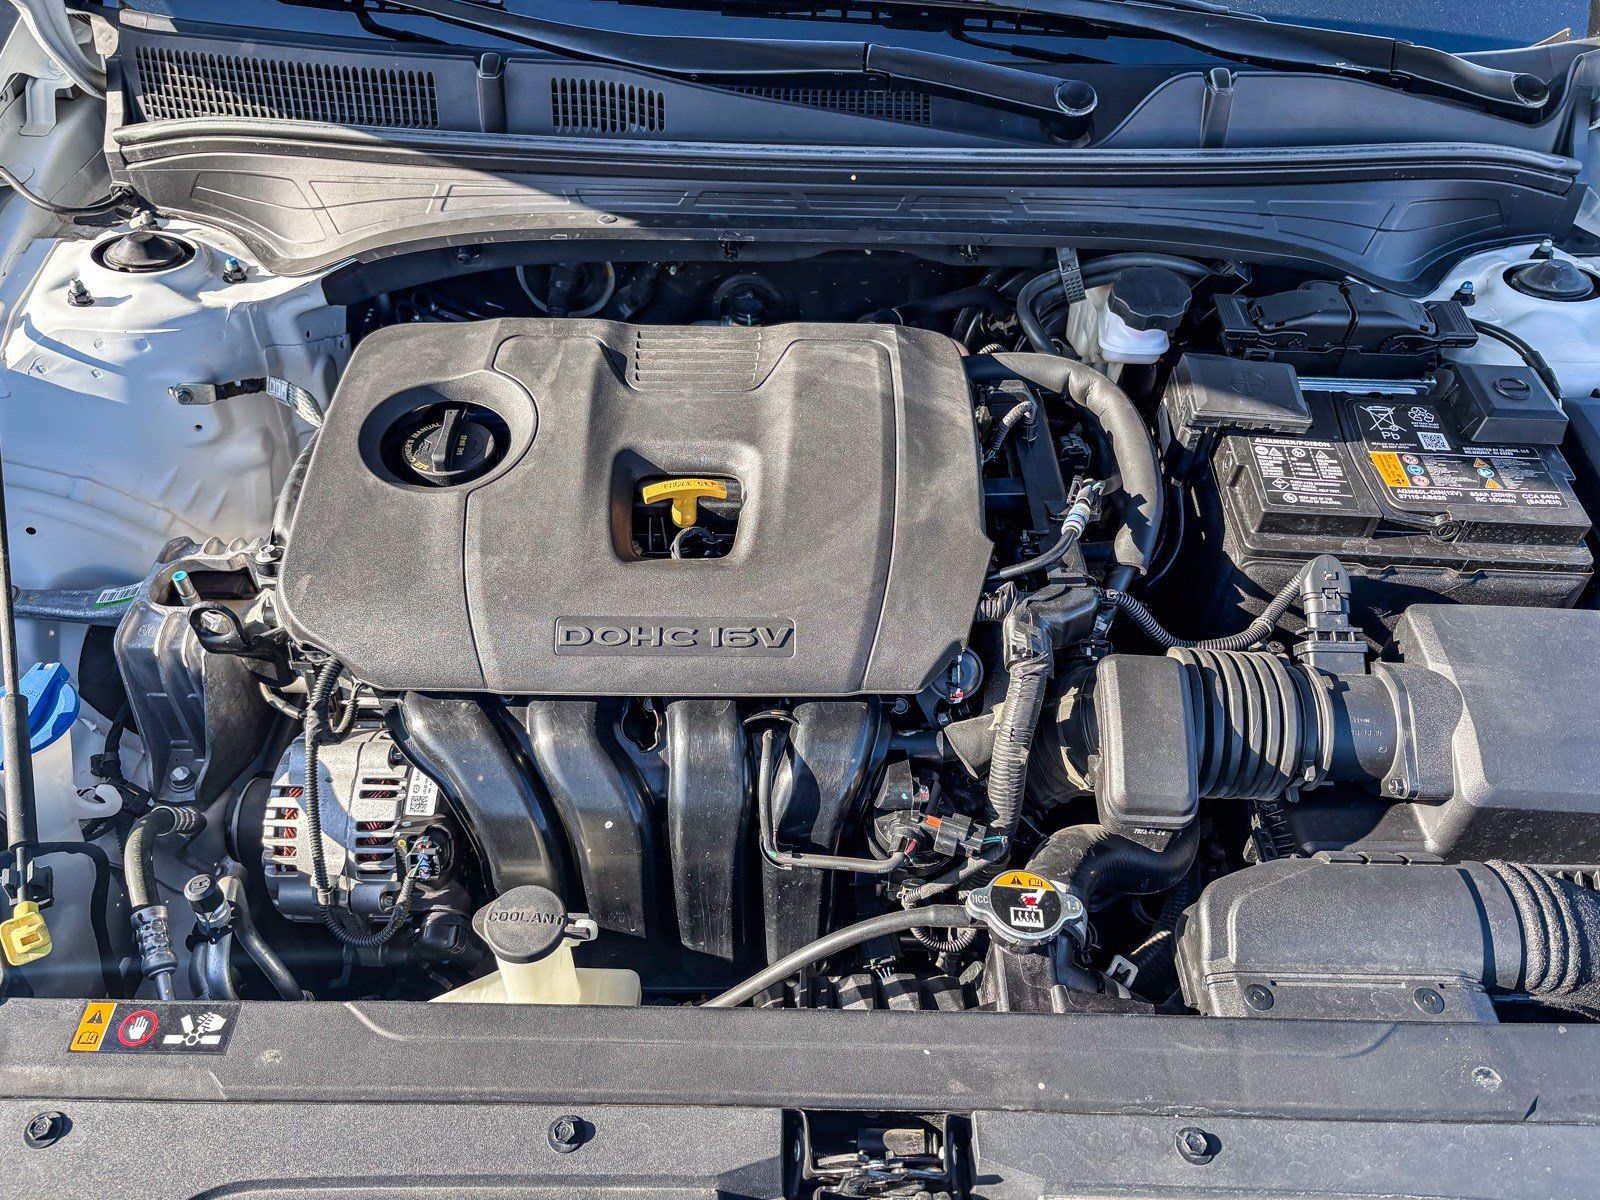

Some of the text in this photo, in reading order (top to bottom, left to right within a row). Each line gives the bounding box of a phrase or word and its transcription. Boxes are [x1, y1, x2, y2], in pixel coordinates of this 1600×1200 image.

[412, 422, 442, 439] MANUAL
[1381, 431, 1401, 440] Pb
[1261, 438, 1331, 447] DANGER/POISON
[413, 461, 429, 471] SEE
[558, 626, 794, 648] DOHC 16V
[1067, 901, 1080, 911] 1.1
[488, 911, 565, 926] COOLANT
